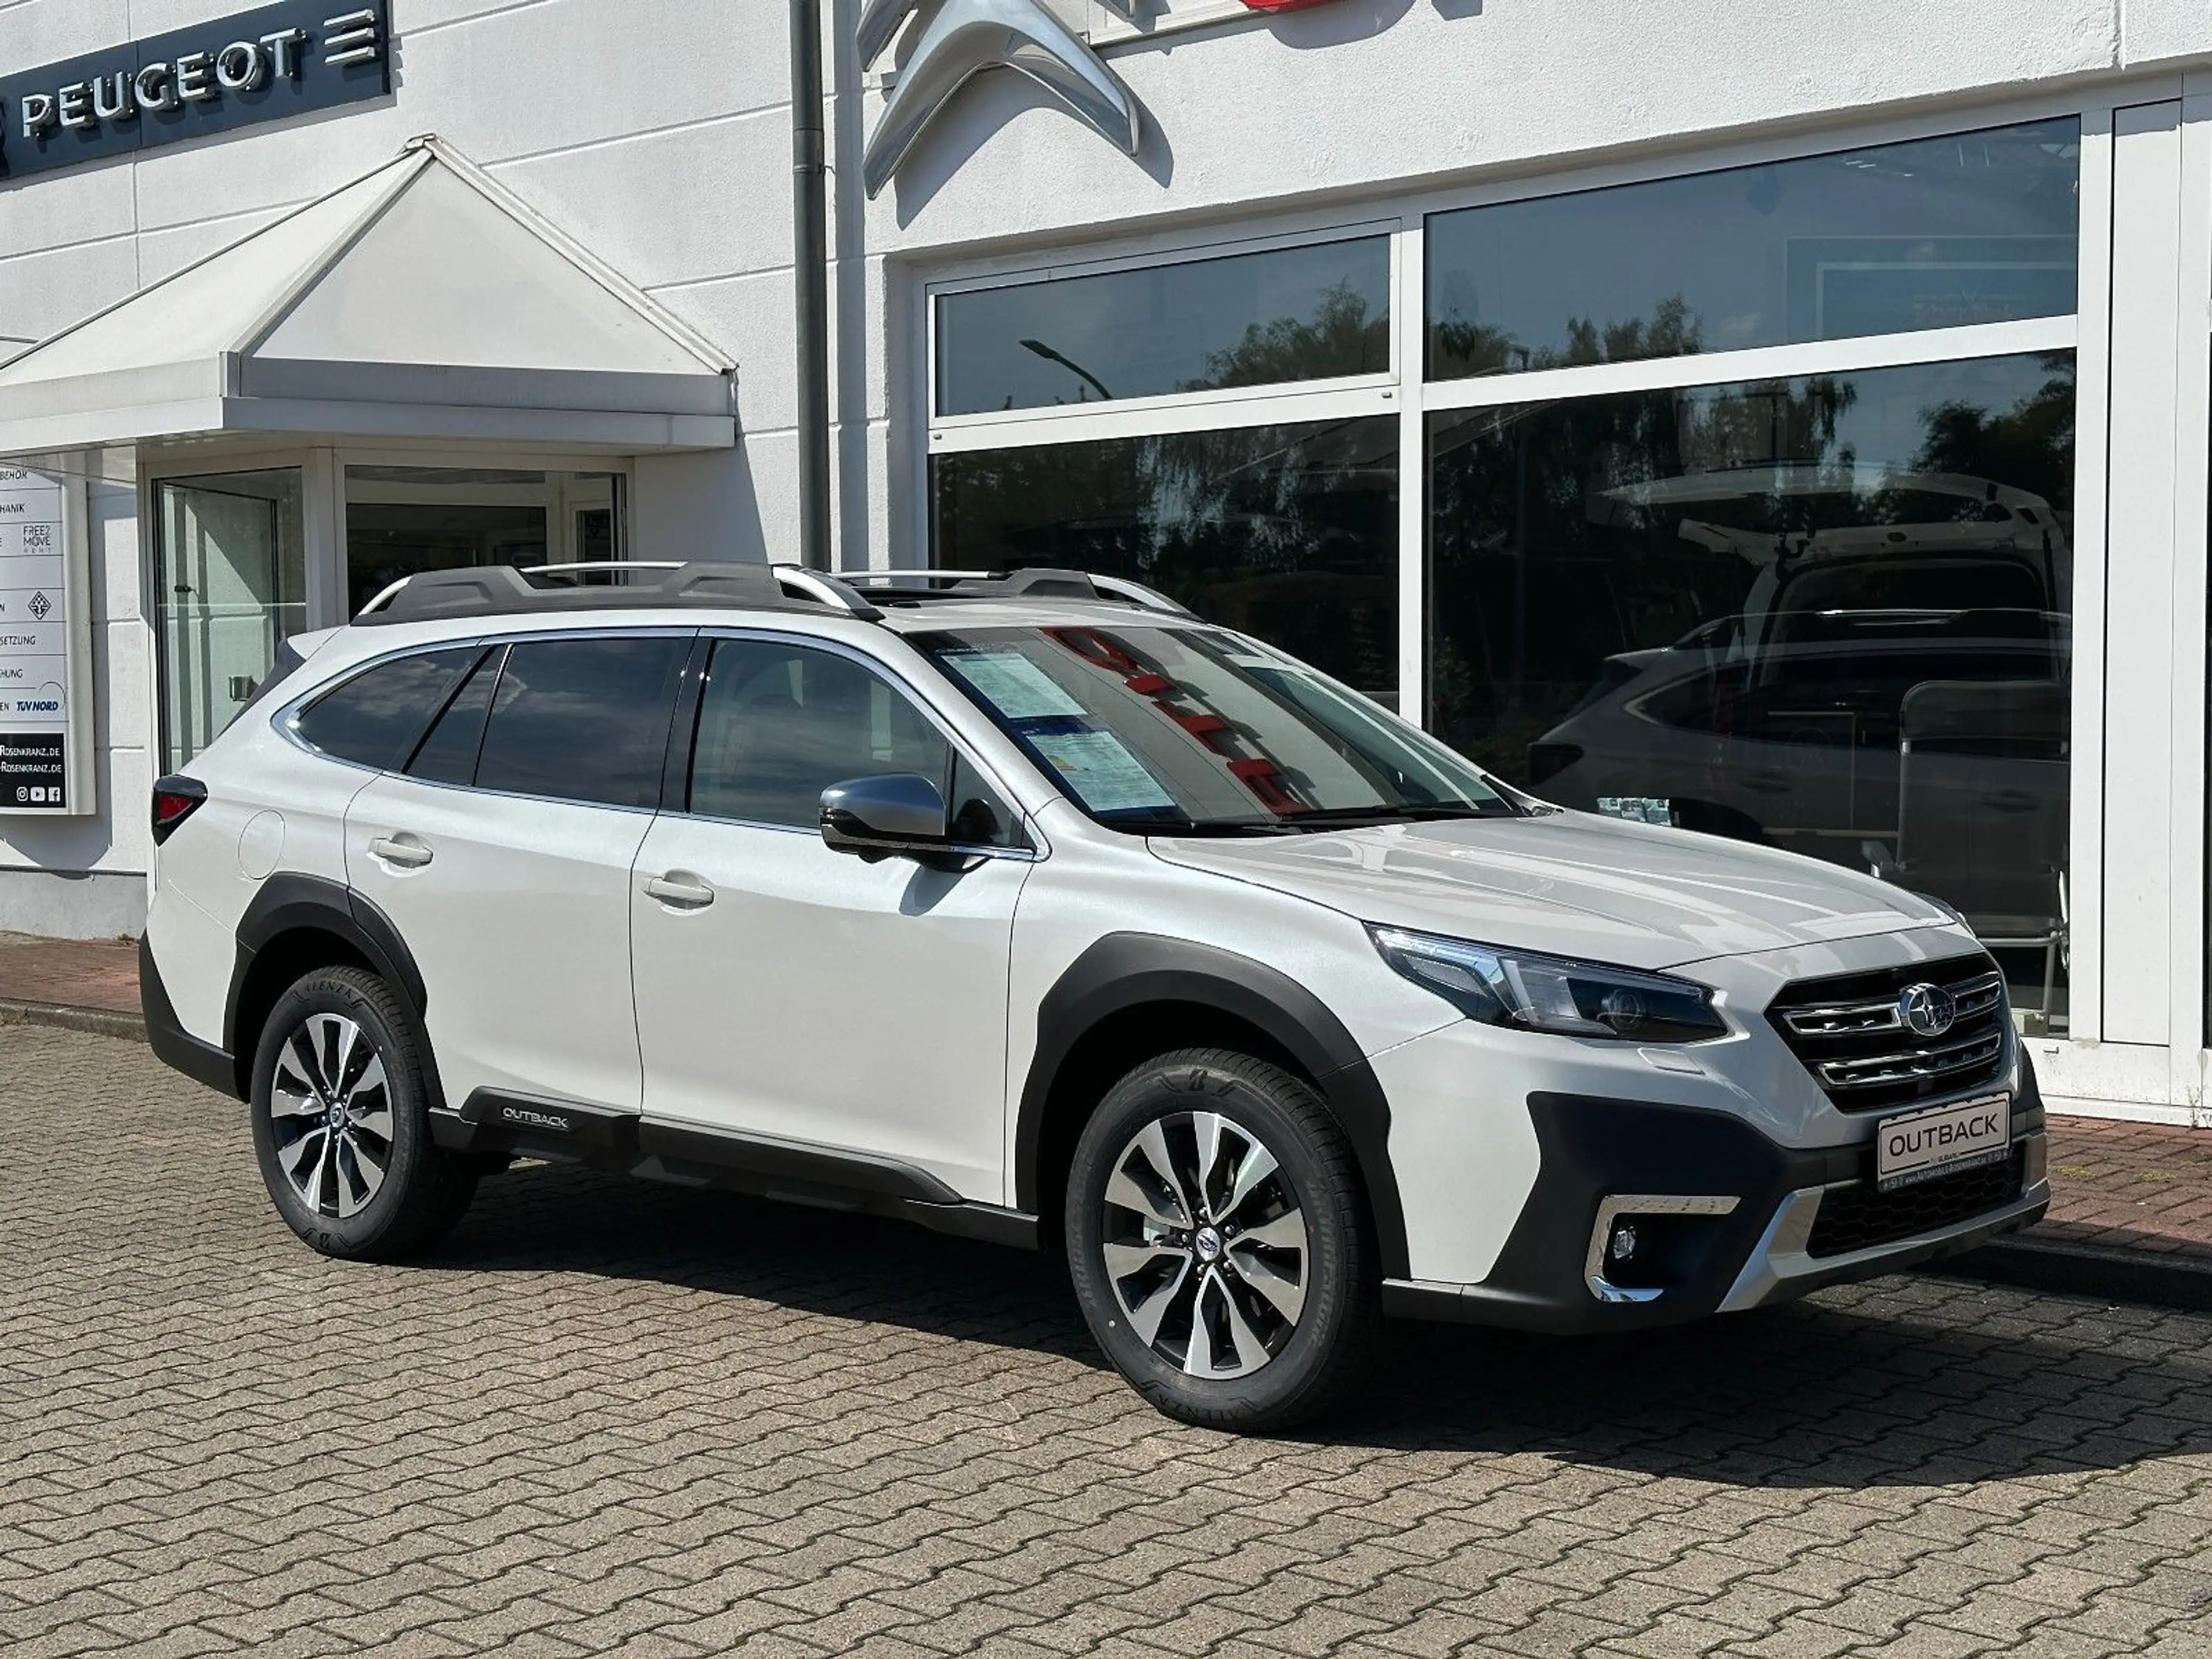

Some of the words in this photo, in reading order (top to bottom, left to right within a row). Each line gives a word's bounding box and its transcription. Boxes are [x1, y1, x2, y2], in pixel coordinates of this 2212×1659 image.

[22, 26, 305, 139] PEUGEOT
[23, 536, 51, 546] MOVE
[32, 701, 59, 711] NORD
[503, 1107, 569, 1128] OUTBACK
[1889, 1113, 1998, 1157] OUTBACK
